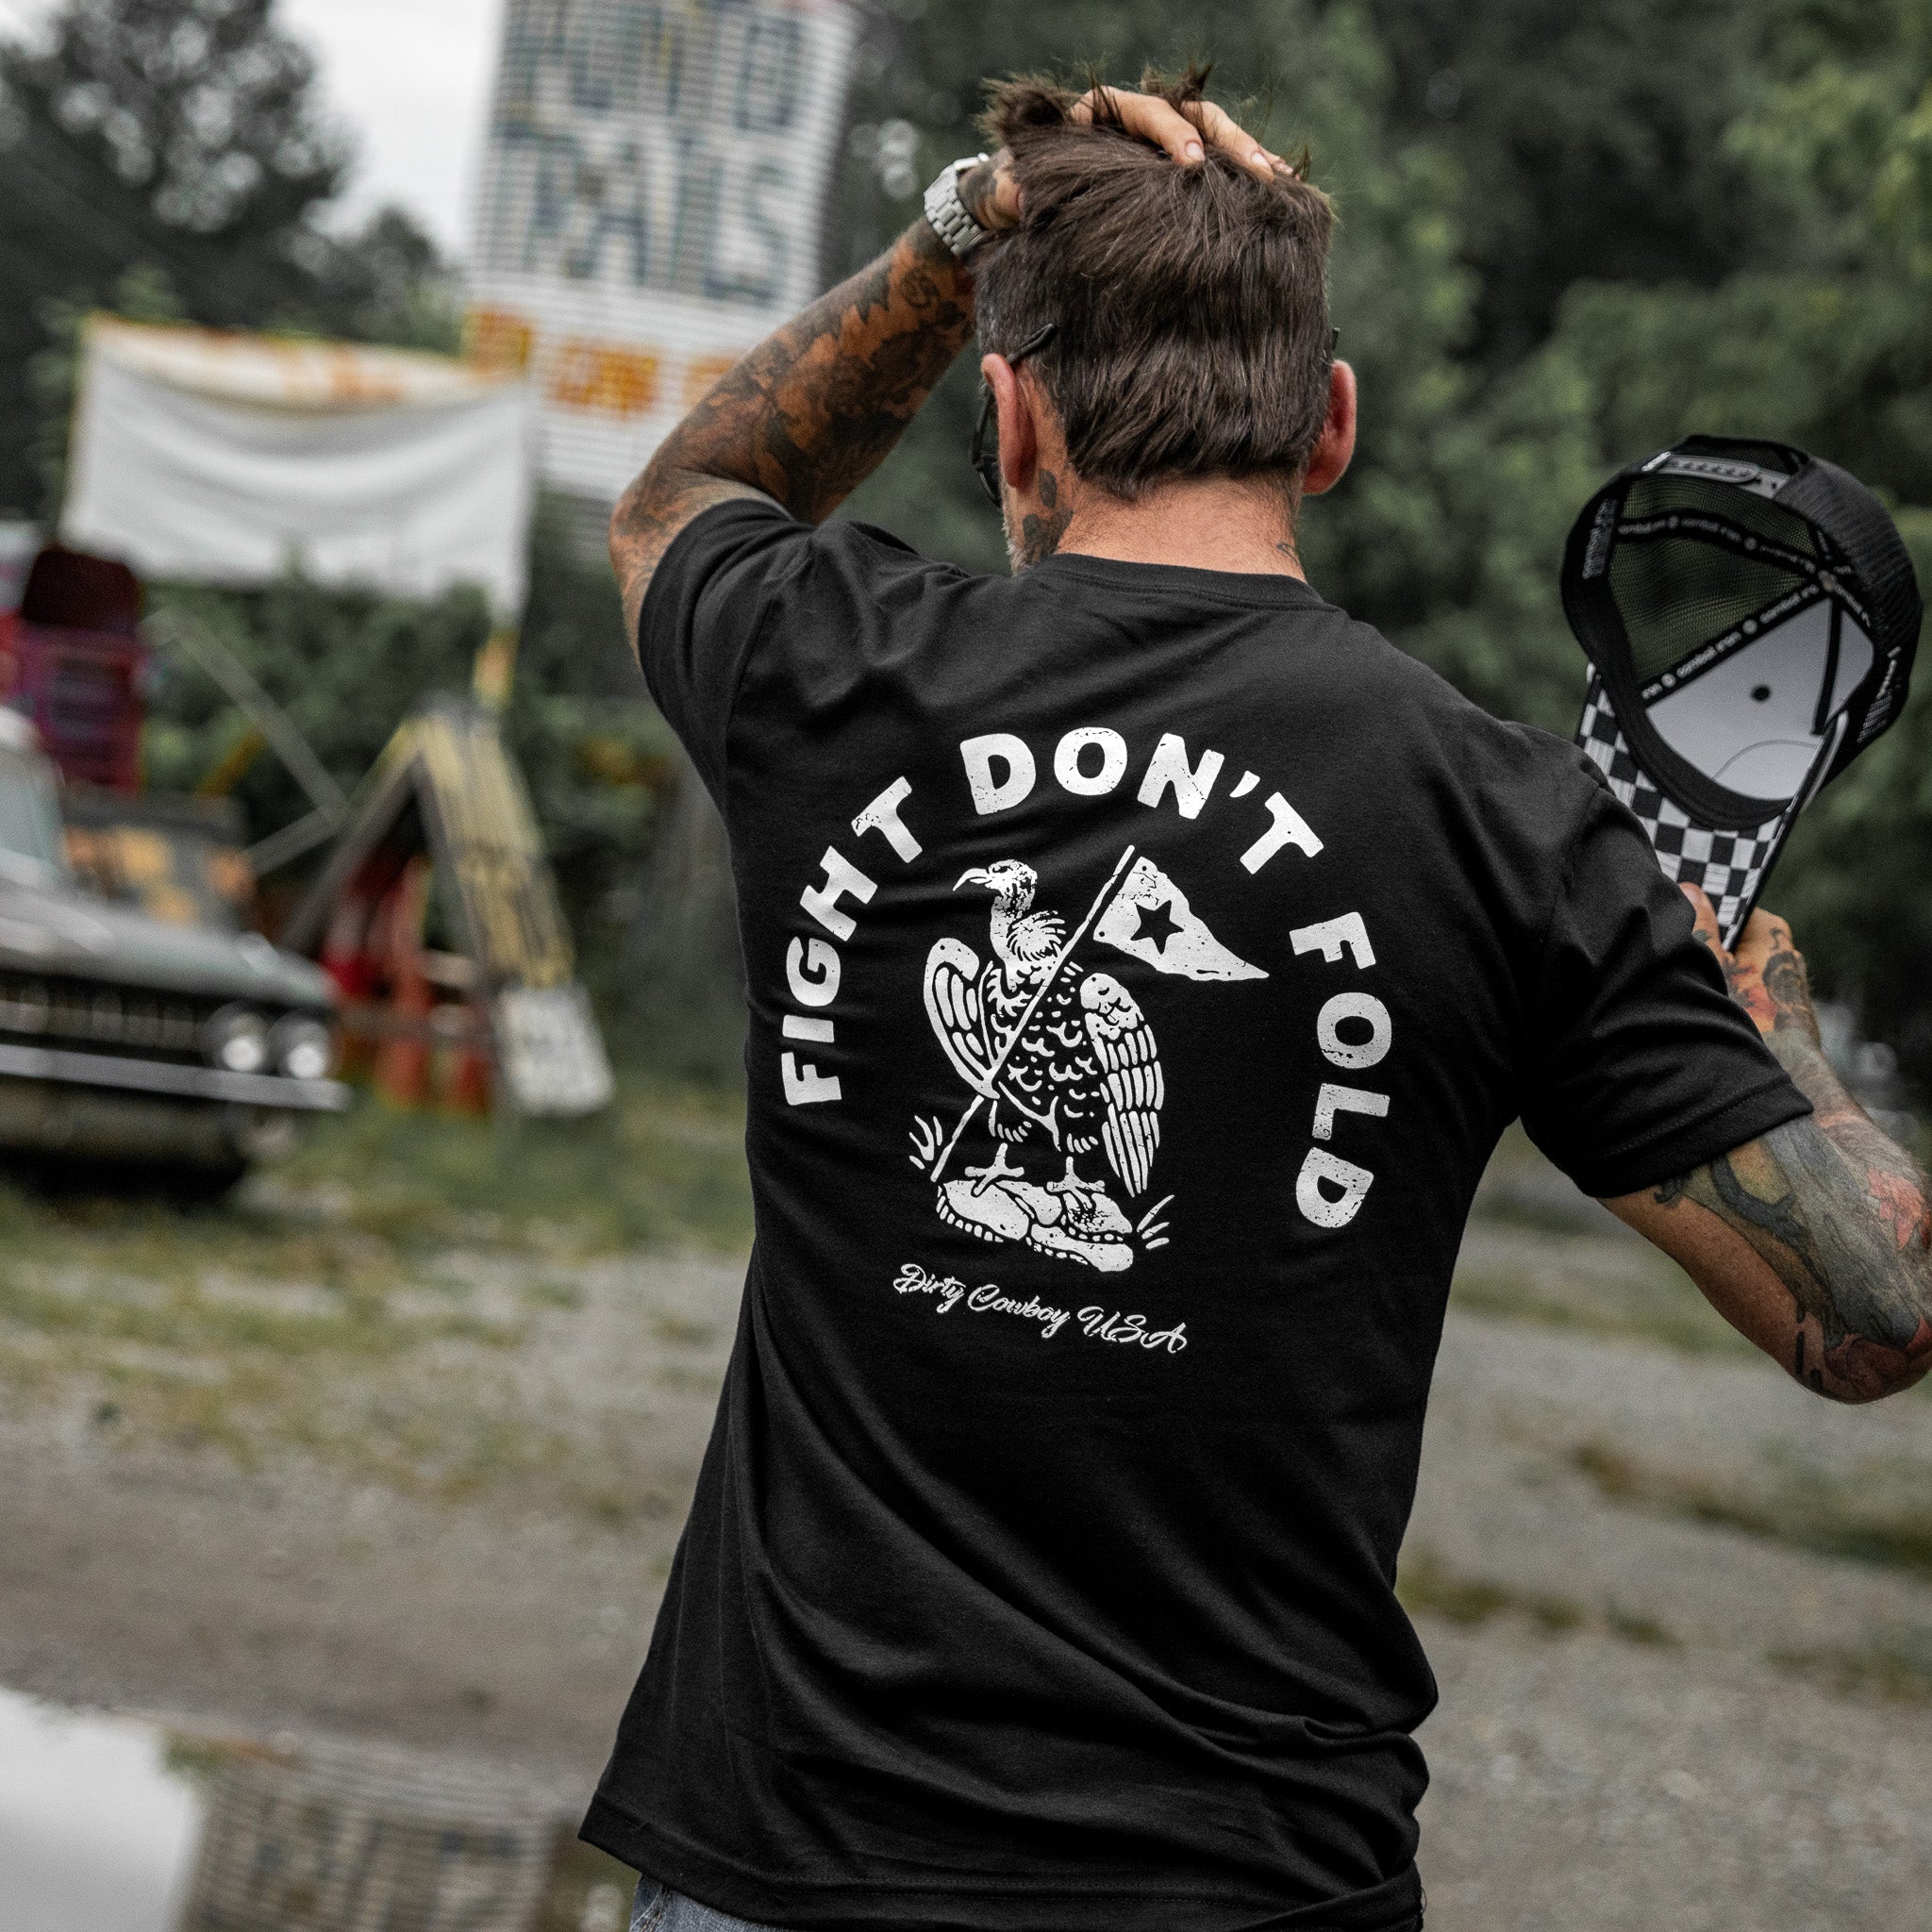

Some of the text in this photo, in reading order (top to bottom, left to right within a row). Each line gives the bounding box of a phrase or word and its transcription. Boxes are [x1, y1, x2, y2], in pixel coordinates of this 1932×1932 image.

[780, 726, 1392, 1228] FIGHT DON'T FOLD
[892, 1263, 1188, 1354] Dirty Cowboy USA
